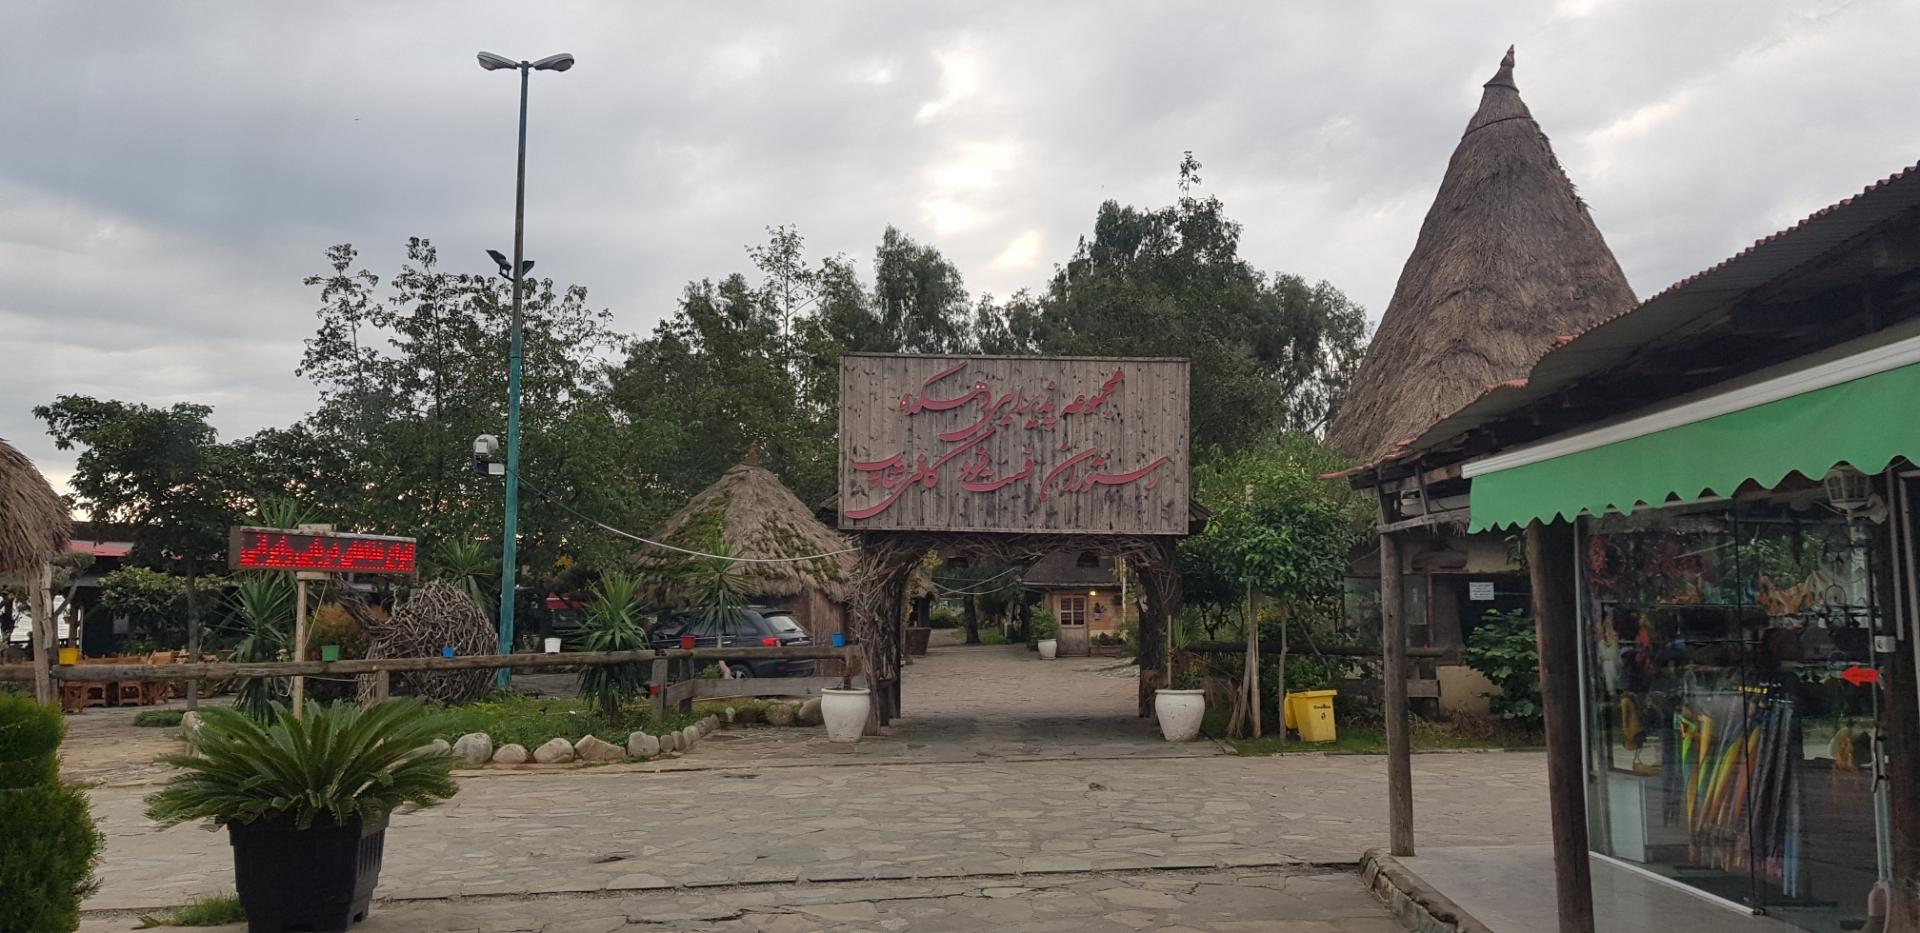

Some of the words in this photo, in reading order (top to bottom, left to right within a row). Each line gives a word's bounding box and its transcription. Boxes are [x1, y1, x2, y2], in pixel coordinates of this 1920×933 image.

[938, 380, 1056, 442] پذیرایی
[1062, 369, 1125, 418] مجموعه
[846, 428, 996, 519] کافی
[852, 452, 905, 489] شاپ
[959, 446, 994, 482] فود
[961, 447, 1034, 492] فست
[1039, 443, 1168, 503] رستوران
